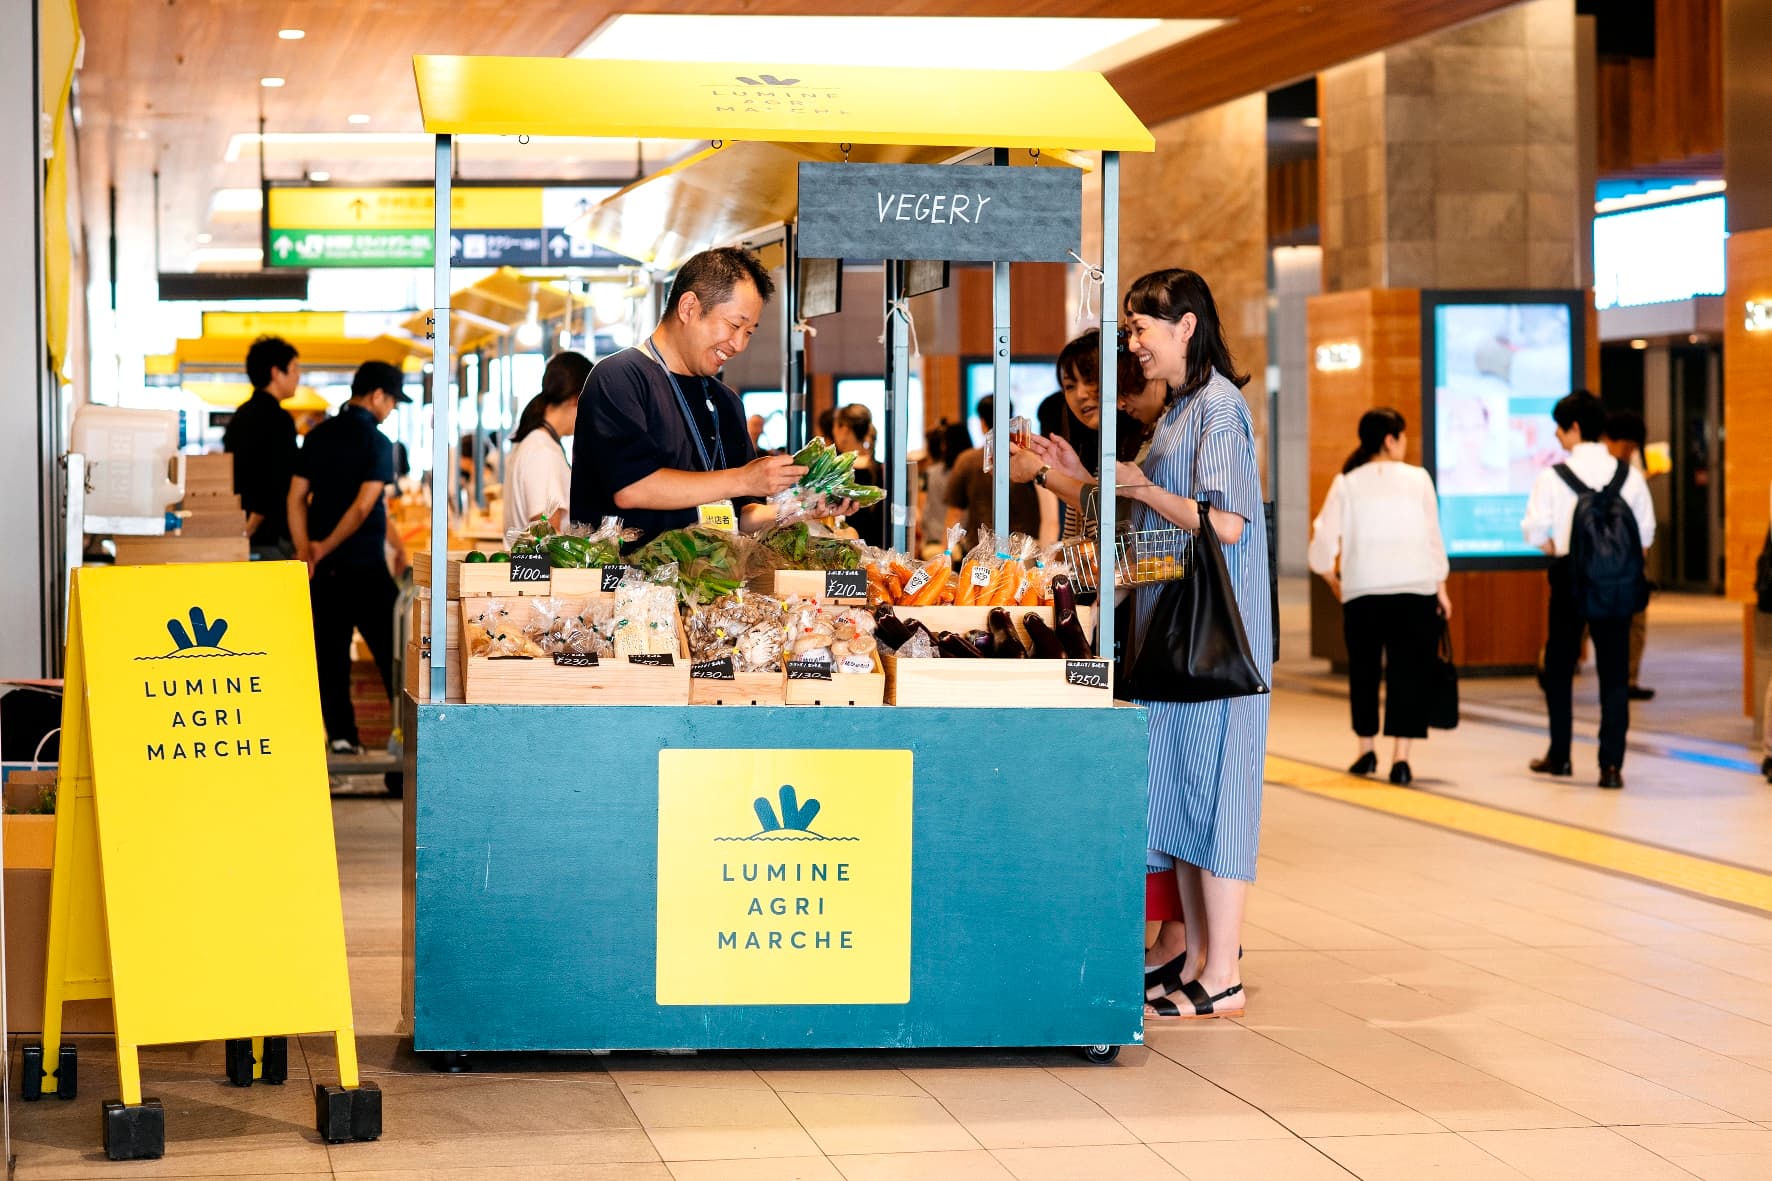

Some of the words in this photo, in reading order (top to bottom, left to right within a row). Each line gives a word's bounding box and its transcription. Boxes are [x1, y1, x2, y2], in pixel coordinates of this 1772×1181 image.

[878, 192, 991, 224] VEGERY
[511, 564, 540, 581] ¥100
[827, 579, 857, 597] ¥210
[788, 671, 822, 679] ¥130
[1069, 671, 1100, 686] ¥250
[145, 676, 262, 697] LUMINE
[172, 709, 241, 728] AGRI
[147, 739, 272, 760] MARCHE
[722, 863, 850, 881] LUMINE
[747, 897, 823, 915] AGRI
[718, 931, 853, 949] MARCHE
